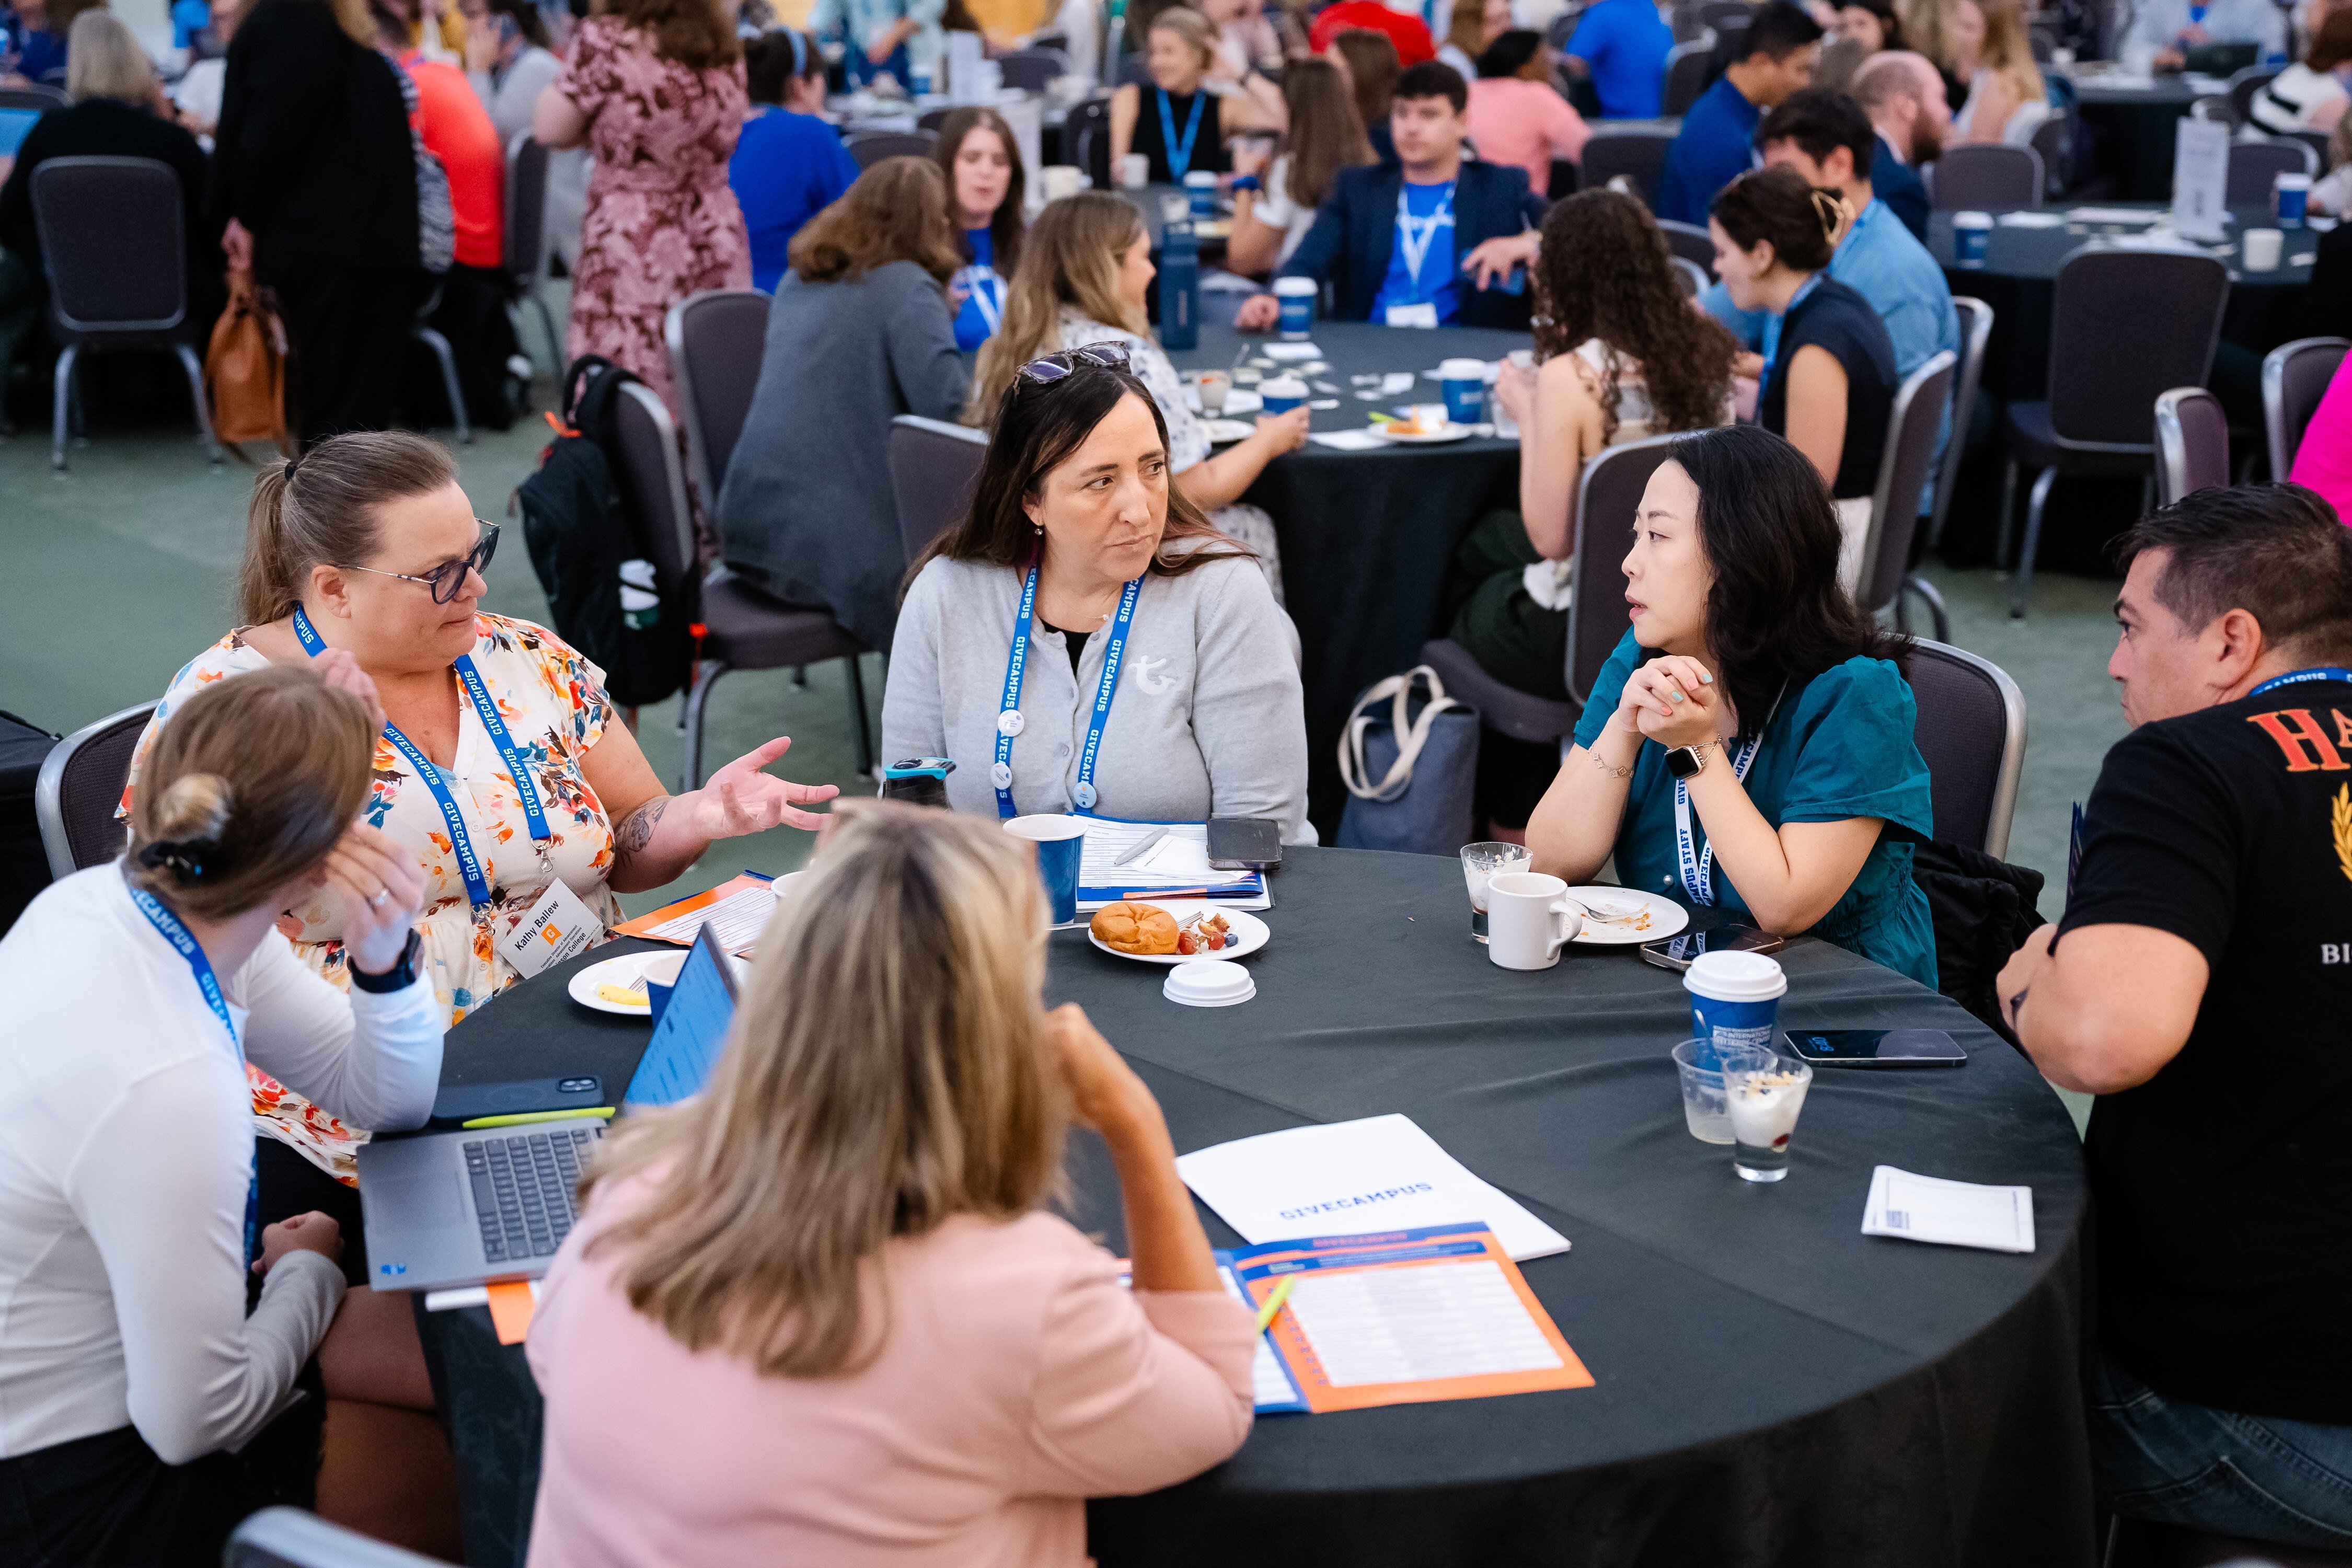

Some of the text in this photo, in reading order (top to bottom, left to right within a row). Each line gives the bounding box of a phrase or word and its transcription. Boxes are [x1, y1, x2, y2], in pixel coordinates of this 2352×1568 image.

[1021, 568, 1036, 619] ECAMPUS
[1119, 577, 1139, 622] CAMPUS
[1006, 636, 1025, 708] GIVECAMPUS
[1097, 639, 1122, 711] GIVECAMPUS
[465, 671, 503, 735] GIVECAMPUS
[385, 728, 440, 786] GIVECAMPUS
[503, 747, 539, 816] GIVECAMPUS
[1081, 729, 1099, 784] GIVECAM
[444, 802, 479, 882] GIVECAMPUS
[1680, 828, 1692, 864] STAFF
[1701, 847, 1712, 903] GIVECAMP
[514, 901, 559, 951] Kathy Ballew
[540, 955, 552, 968] Executive
[550, 944, 561, 956] Director
[562, 924, 578, 942] Advancement
[555, 940, 571, 958] Advancement
[569, 926, 582, 941] Operations
[568, 932, 586, 953] College
[2321, 943, 2352, 964] BI
[1279, 1182, 1433, 1220] GIVECAMPUS
